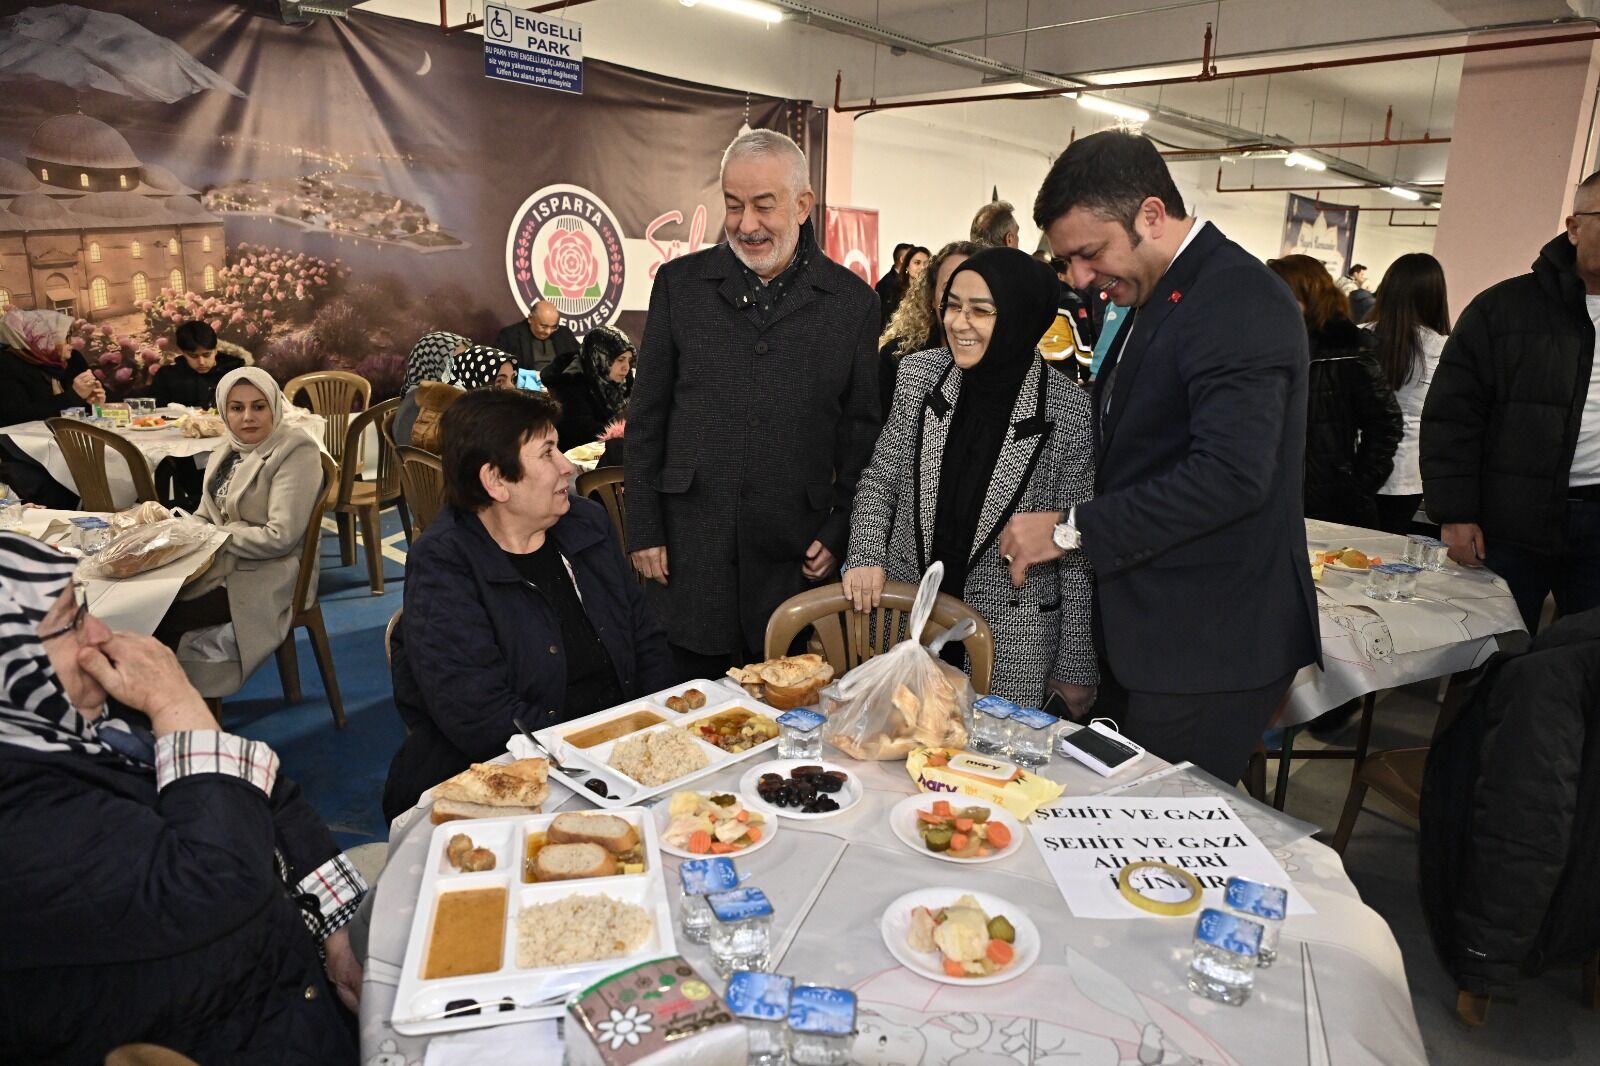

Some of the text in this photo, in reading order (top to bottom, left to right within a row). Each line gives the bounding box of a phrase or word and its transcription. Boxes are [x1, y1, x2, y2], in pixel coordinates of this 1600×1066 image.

[514, 15, 582, 42] ENGELLİ
[485, 45, 493, 54] BU
[493, 47, 507, 57] PARK
[507, 50, 519, 59] YERİ
[519, 52, 540, 63] ENGELLİ
[527, 36, 570, 56] PARK
[497, 60, 511, 68] veya
[535, 67, 553, 76] engelli
[520, 73, 535, 81] alana
[535, 76, 547, 84] park
[532, 196, 602, 227] ISPARTA
[530, 297, 614, 332] EDİYESİ
[966, 759, 1001, 771] mary
[1035, 806, 1231, 822] ŞEHİT VE GAZİ
[1043, 833, 1249, 851] ŞEHİT VE GAZİ
